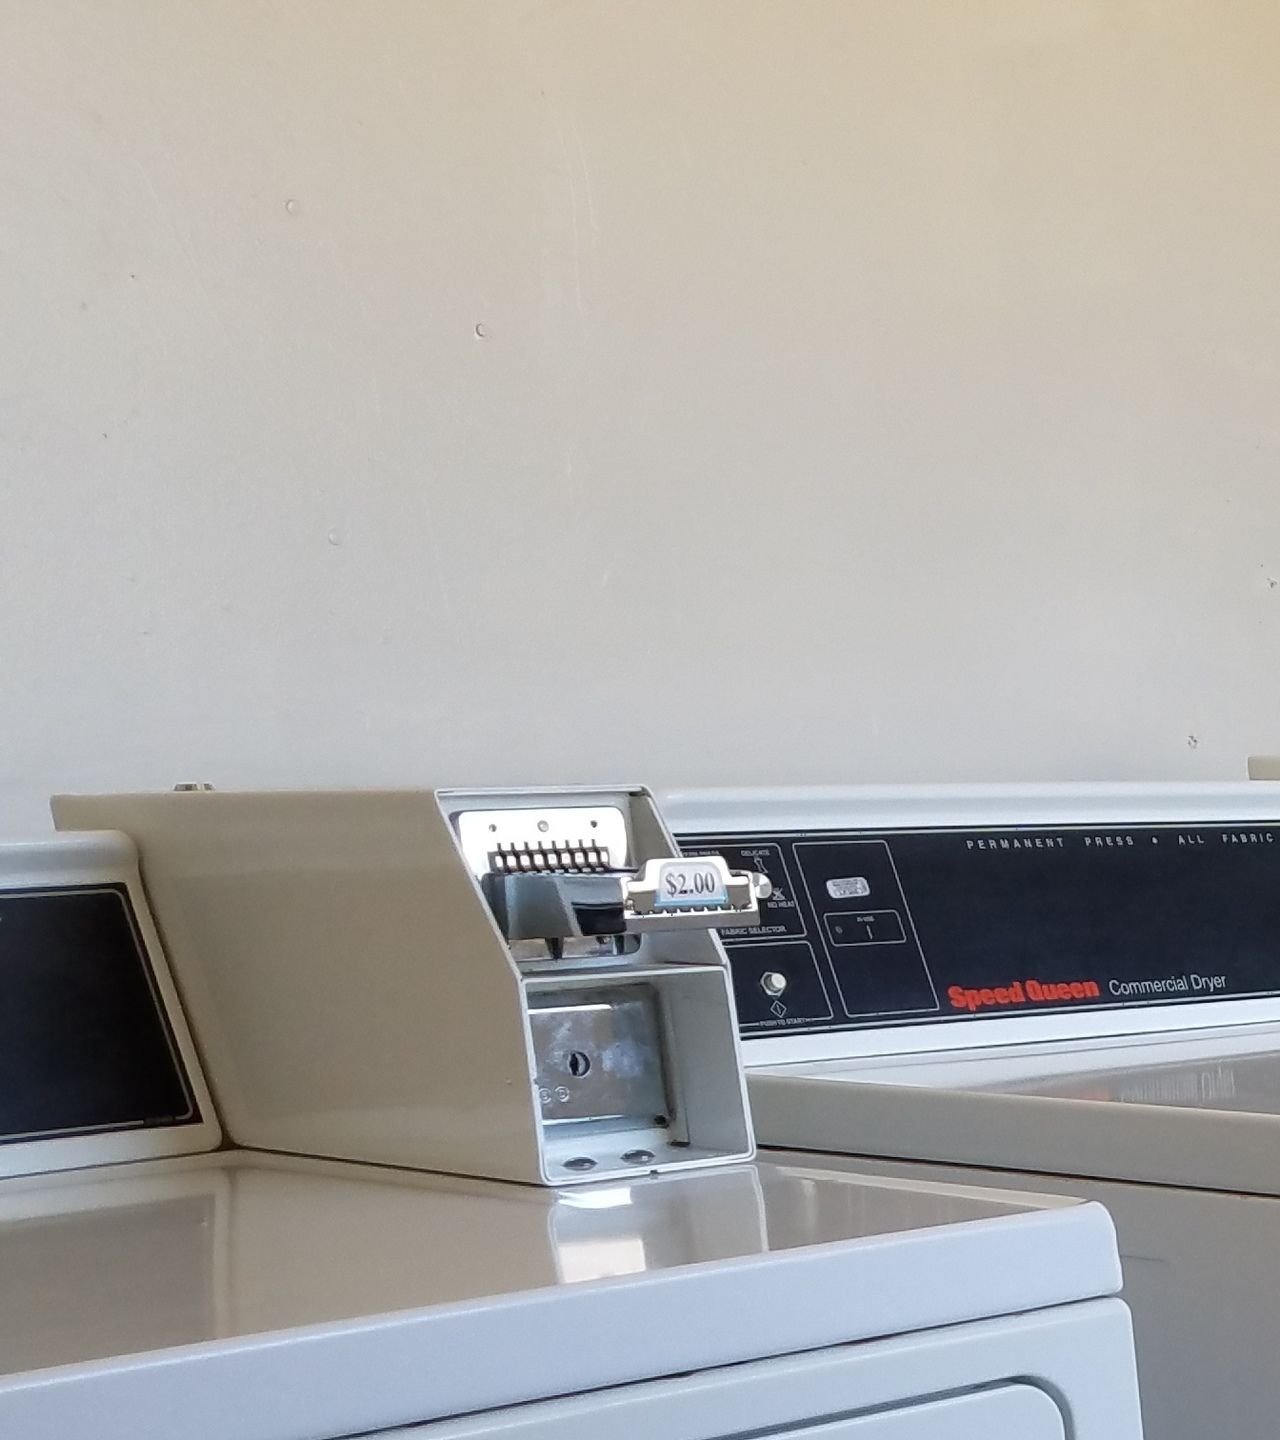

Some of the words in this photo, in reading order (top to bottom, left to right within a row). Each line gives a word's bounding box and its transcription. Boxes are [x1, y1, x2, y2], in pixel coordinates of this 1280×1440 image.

[966, 837, 1064, 850] PERMANENT
[1084, 835, 1134, 847] PRESS
[1178, 833, 1205, 845] ALL
[1222, 832, 1274, 843] FABRIC
[665, 872, 715, 898] $2.00
[721, 926, 748, 936] FABRIC
[748, 925, 788, 935] SELECTOR
[947, 981, 1026, 1012] Speed
[1025, 979, 1100, 1001] Queen
[1108, 975, 1189, 996] Commercial
[1190, 974, 1226, 992] Dryer
